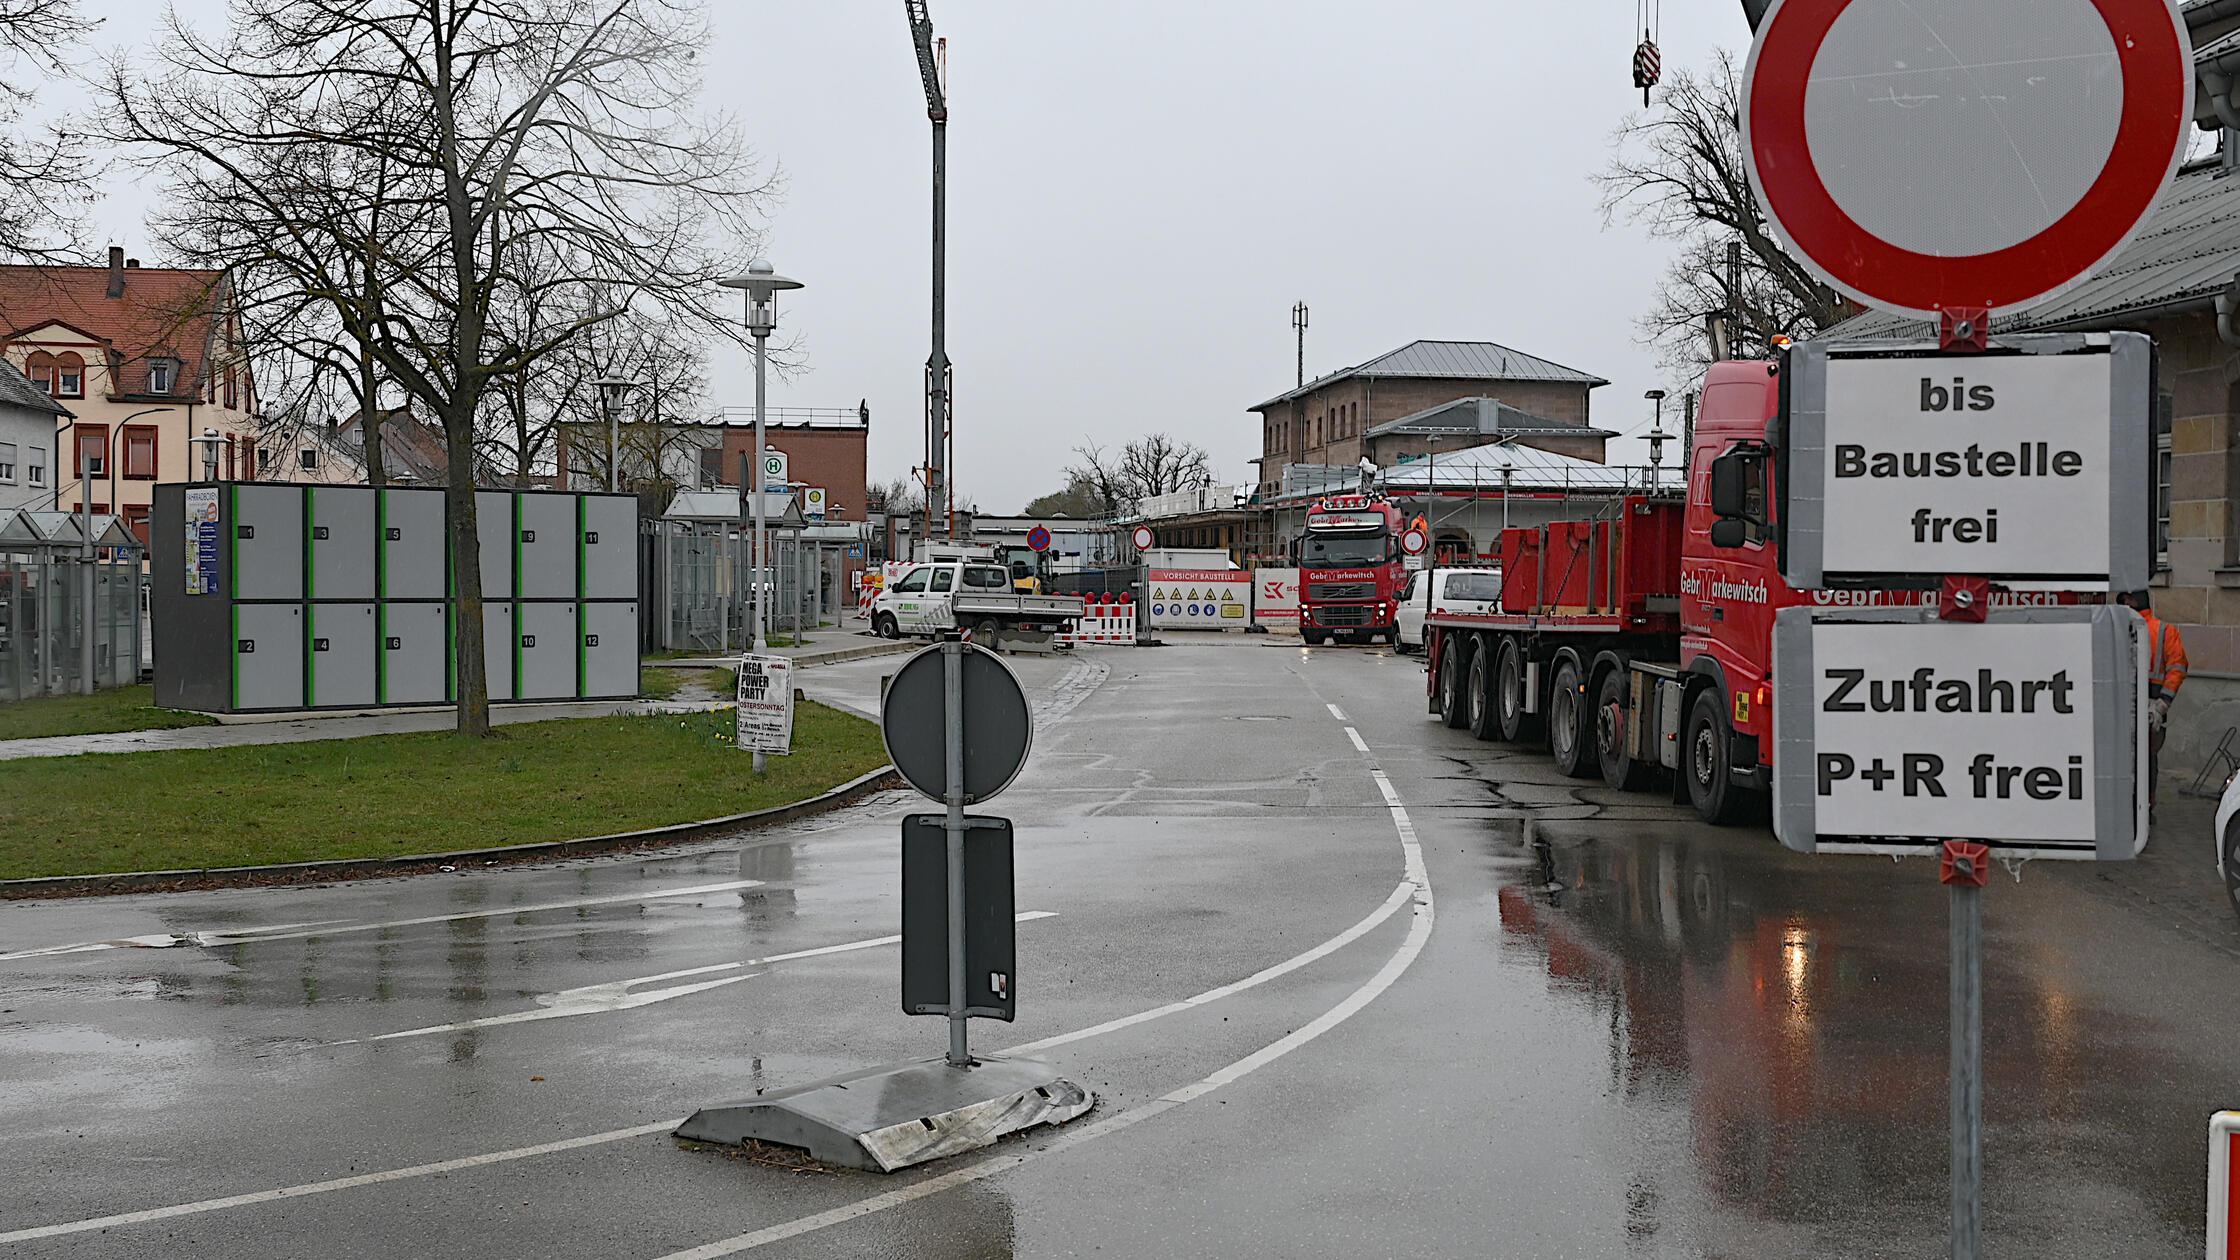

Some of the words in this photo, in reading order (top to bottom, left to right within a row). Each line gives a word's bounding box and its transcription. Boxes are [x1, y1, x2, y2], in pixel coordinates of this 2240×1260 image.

[1920, 377, 1995, 411] bis
[1834, 441, 2083, 478] Baustelle
[1910, 508, 1998, 544] frei
[246, 528, 253, 538] 1
[319, 530, 327, 539] 3
[392, 530, 399, 539] 5
[528, 533, 534, 541] 9
[588, 534, 597, 542] 11
[1163, 572, 1198, 580] VORSICHT
[1680, 570, 1700, 595] Gebr
[1697, 568, 1767, 604] Markewitsch
[320, 640, 328, 650] 4
[392, 639, 399, 648] 6
[524, 636, 534, 646] 10
[587, 635, 598, 645] 12
[245, 641, 253, 651] 2
[743, 662, 762, 675] MEGA
[741, 675, 769, 688] POWER
[740, 687, 765, 700] PARTY
[1822, 668, 2074, 714] Zufahrt
[740, 702, 784, 711] OSTERSONNTAG
[1816, 752, 1947, 798] P+R
[1968, 753, 2083, 800] frei
